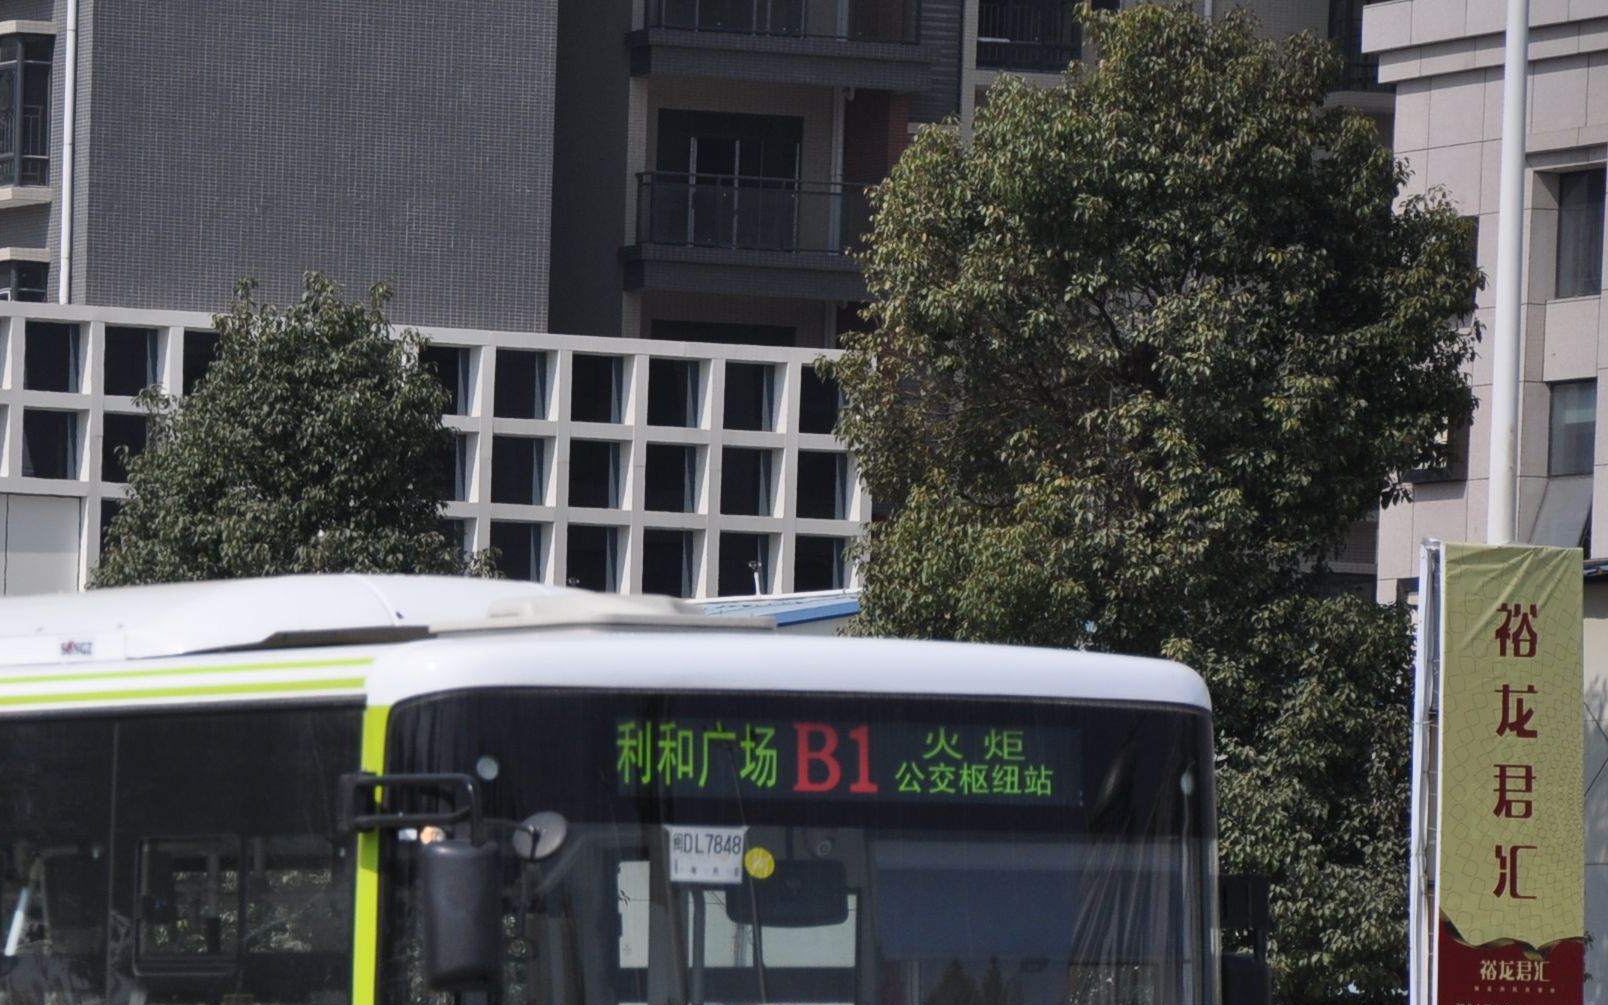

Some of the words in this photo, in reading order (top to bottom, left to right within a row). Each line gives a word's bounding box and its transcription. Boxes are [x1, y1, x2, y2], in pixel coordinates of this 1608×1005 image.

[616, 719, 779, 788] 利和广场
[793, 722, 879, 794] B1
[895, 761, 1054, 797] 公交枢纽站
[1493, 602, 1539, 900] 裕龙君汇
[1479, 960, 1551, 982] 裕龙君汇
